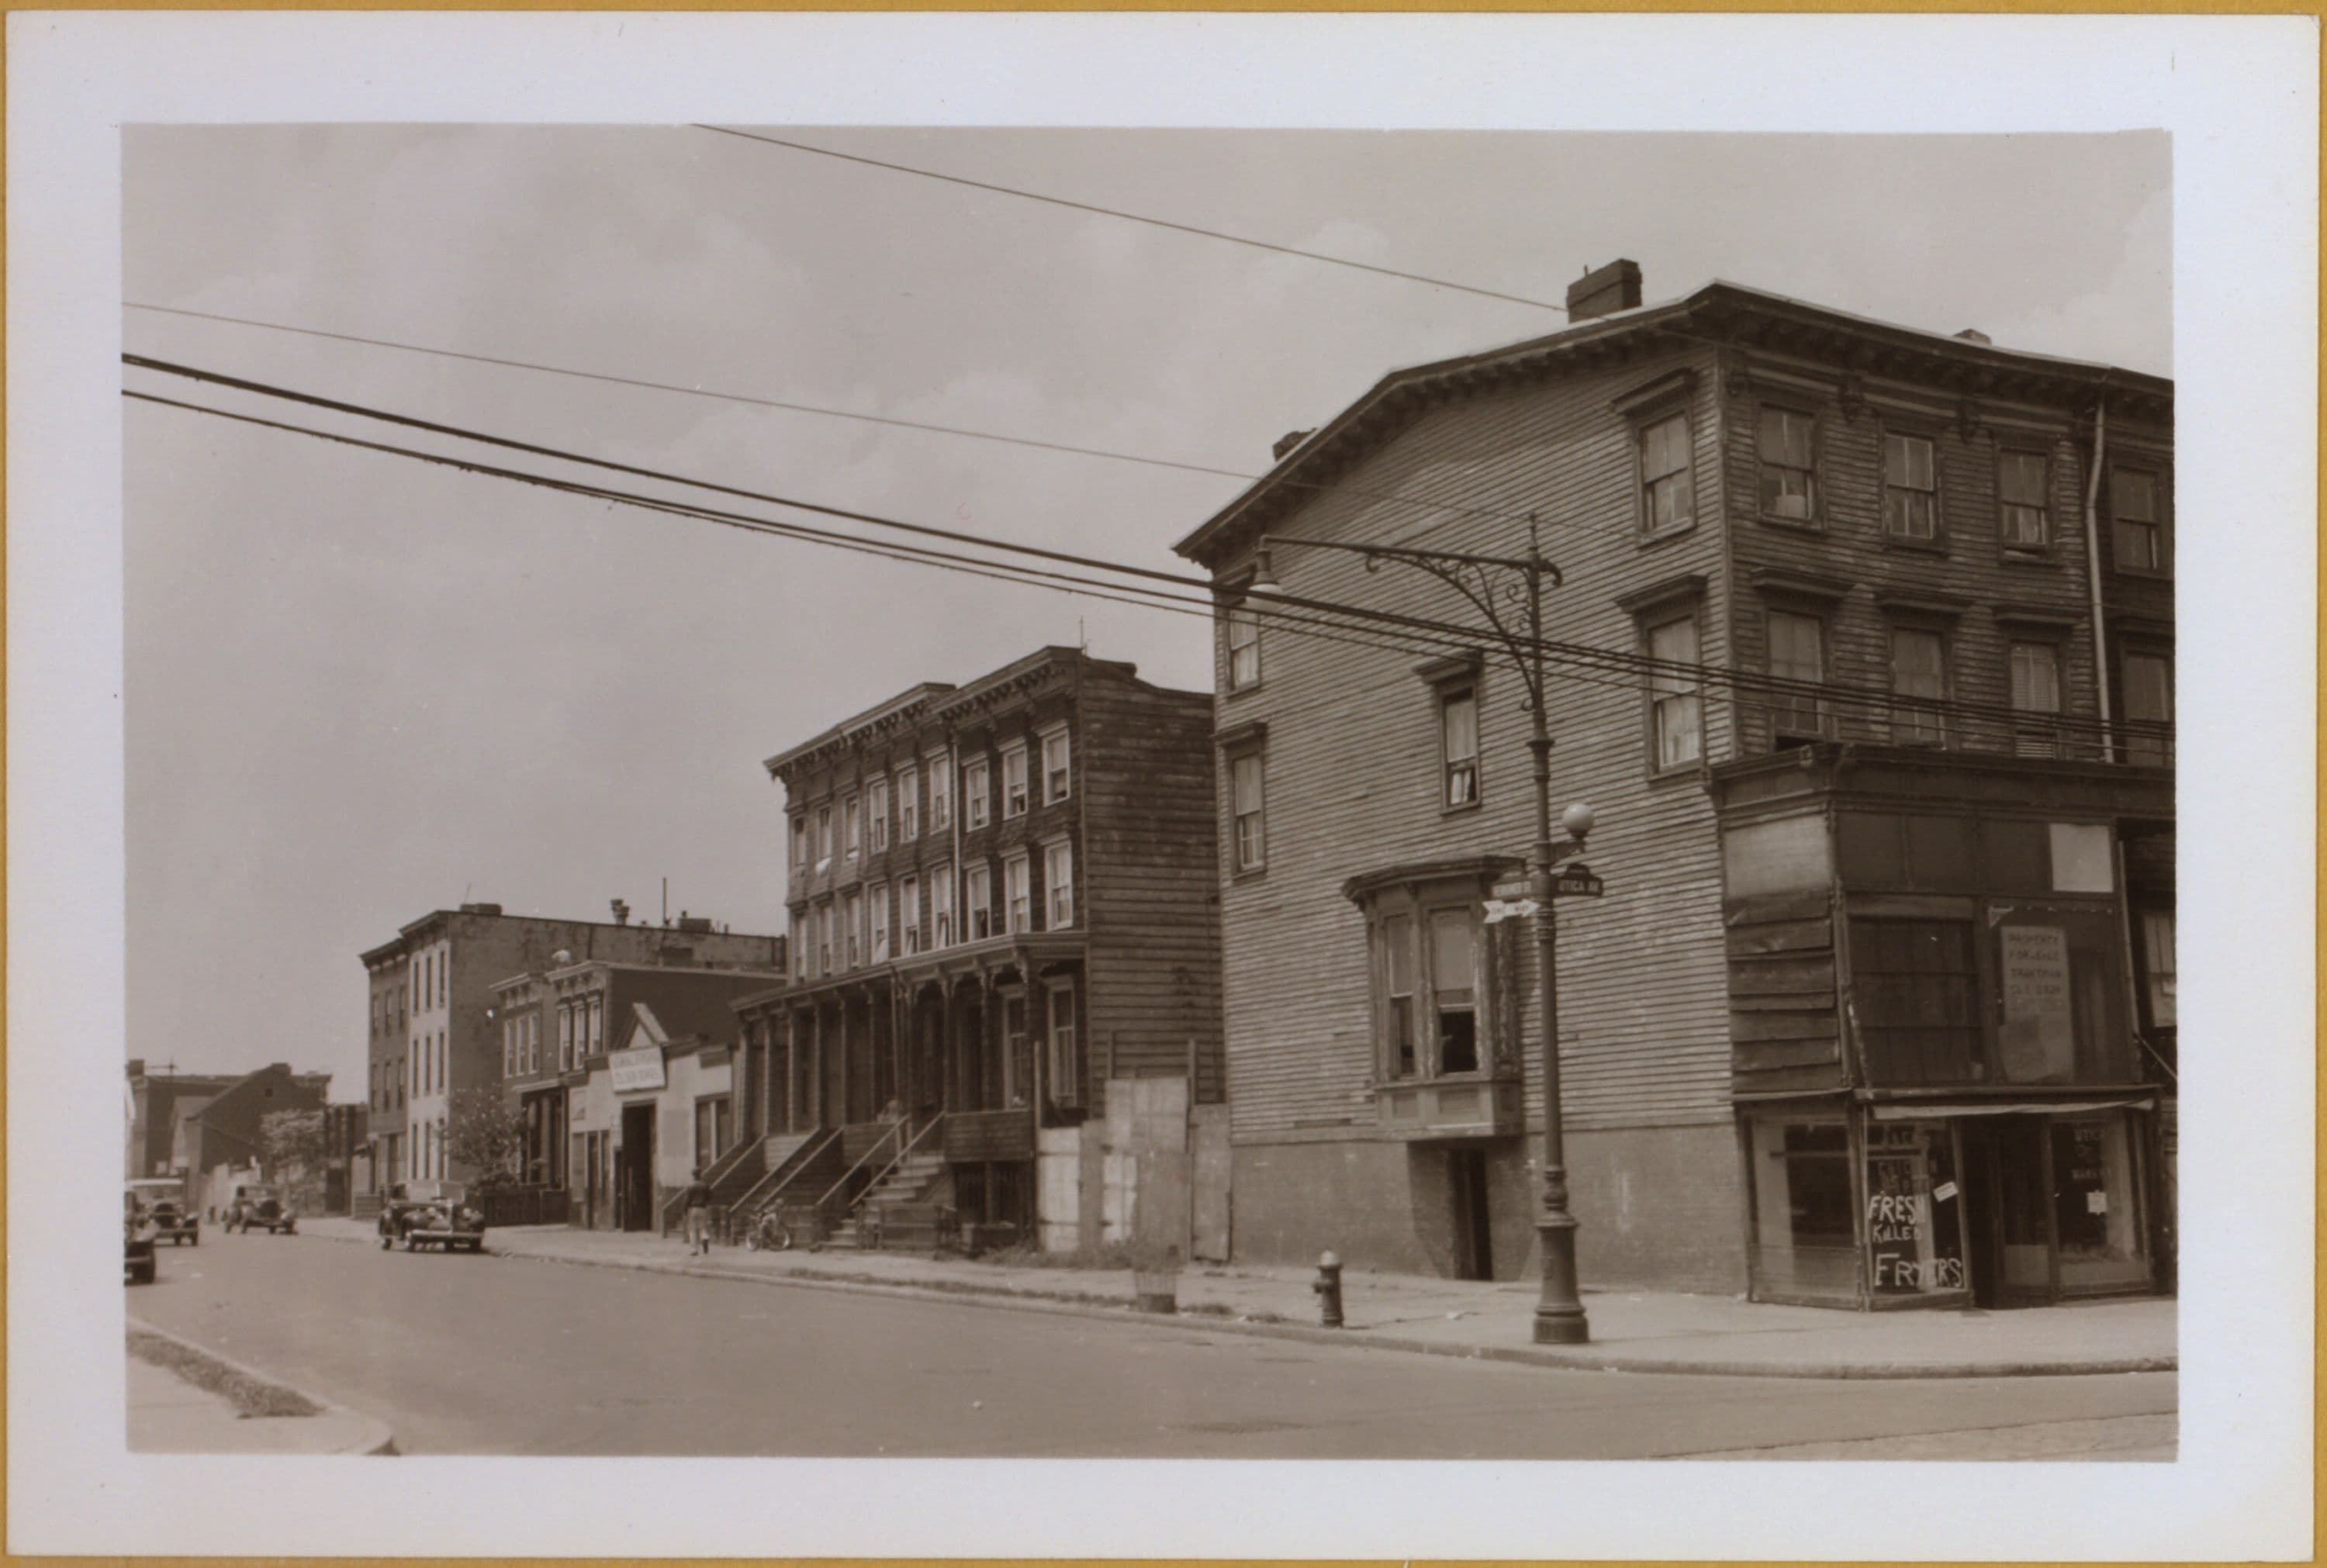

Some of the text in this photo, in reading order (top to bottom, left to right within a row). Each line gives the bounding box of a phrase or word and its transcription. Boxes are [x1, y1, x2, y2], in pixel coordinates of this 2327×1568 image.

[1558, 879, 1585, 893] UTICA
[1868, 1194, 1926, 1225] FRESH
[1873, 1252, 1964, 1288] FRYERS
